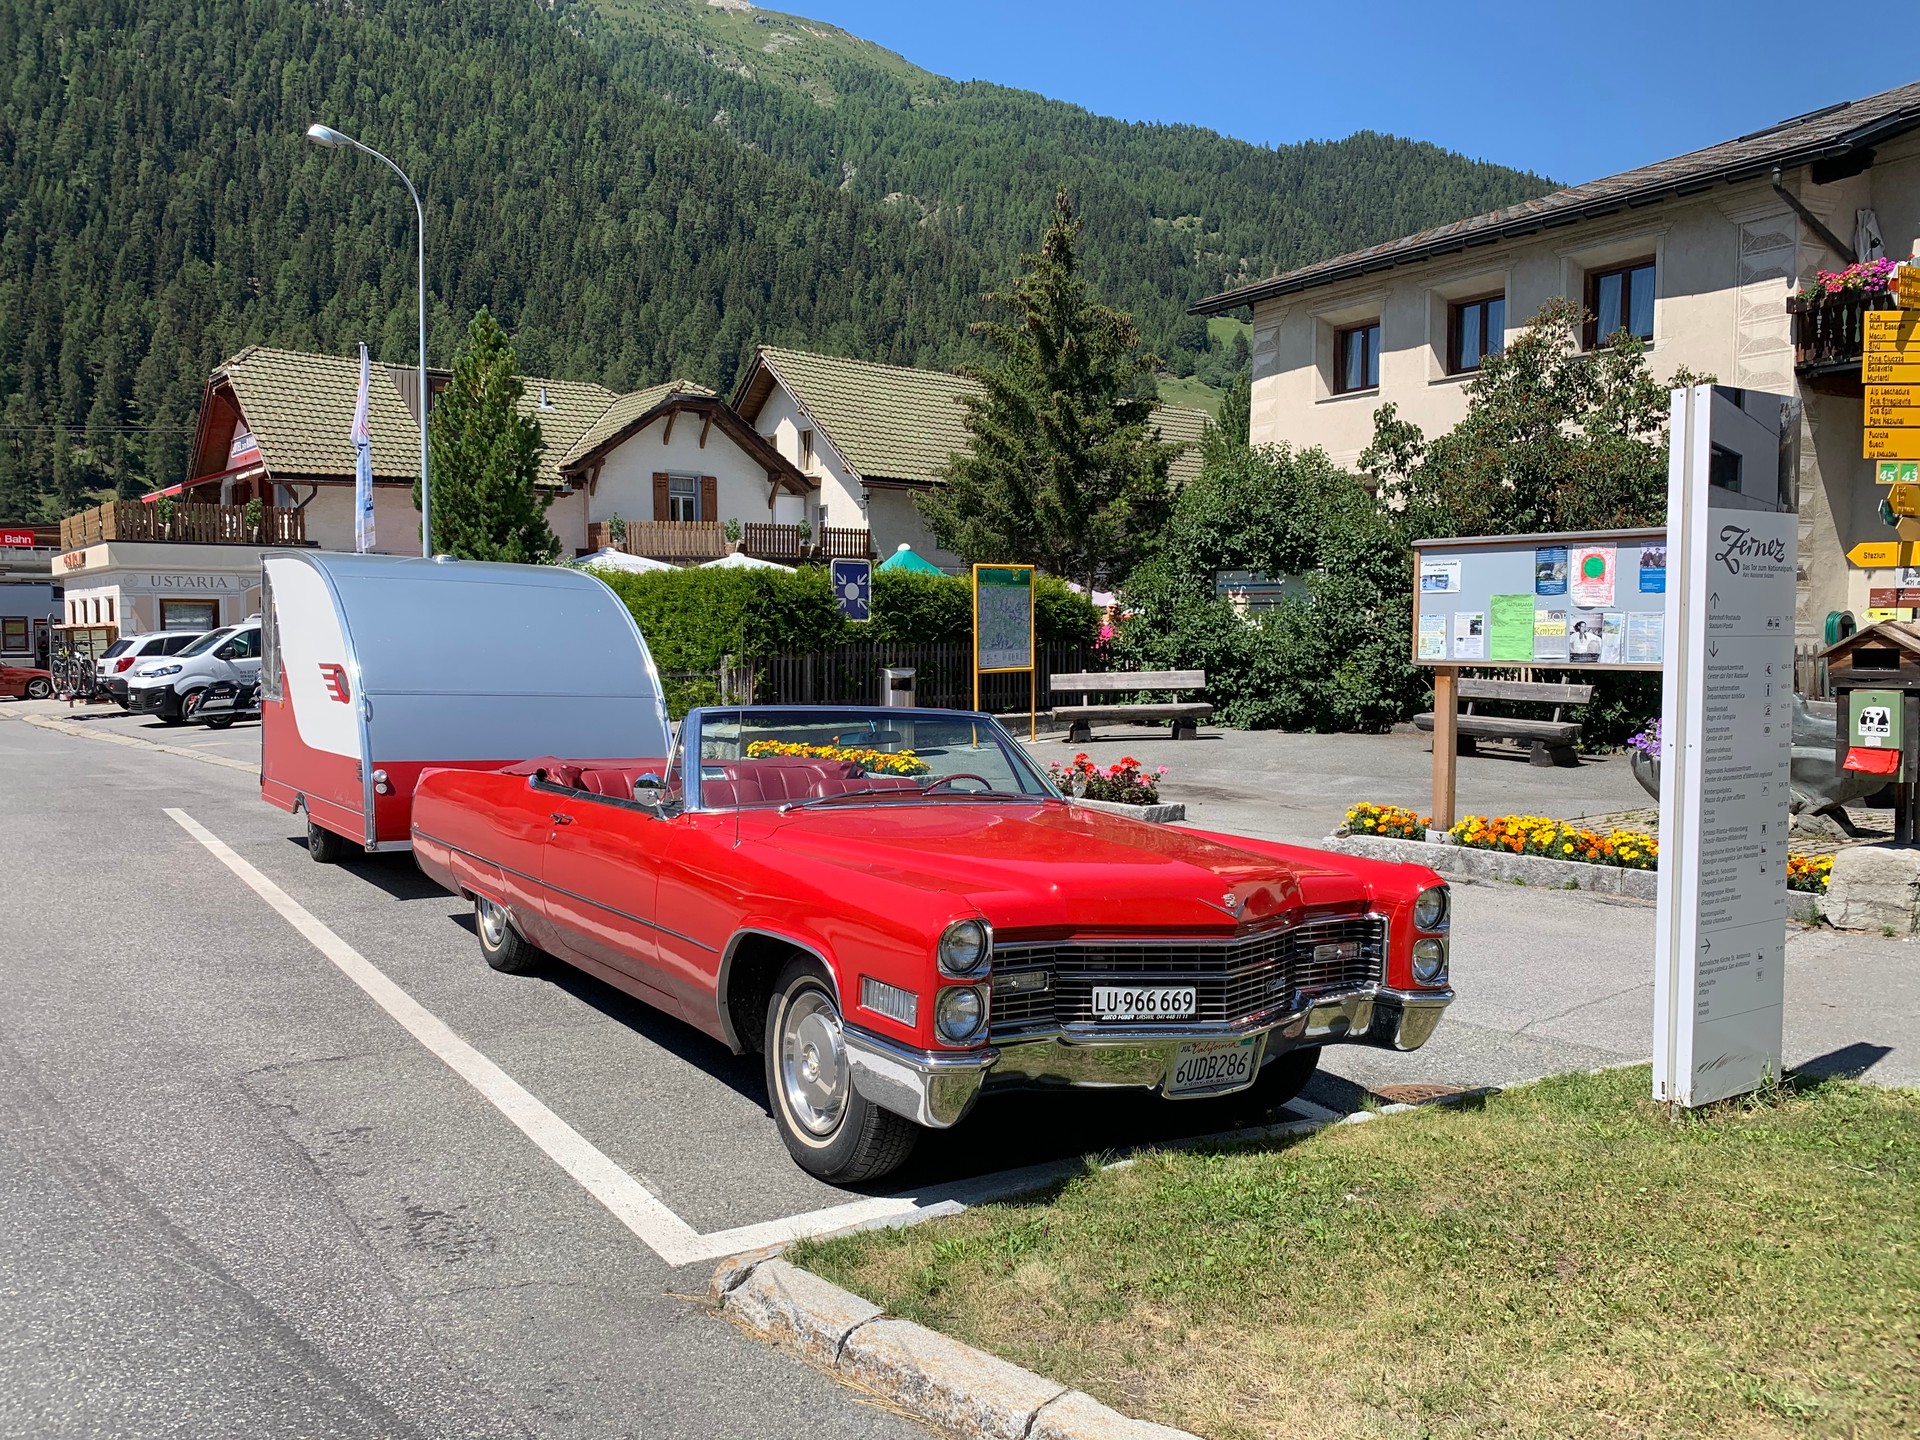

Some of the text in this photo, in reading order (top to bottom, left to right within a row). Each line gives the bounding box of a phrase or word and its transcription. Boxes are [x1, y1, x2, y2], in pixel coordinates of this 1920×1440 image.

[1880, 470, 1894, 481] 45
[1902, 472, 1918, 481] 43
[5, 535, 31, 543] Bahn
[1715, 525, 1785, 575] Zernez
[151, 575, 228, 589] USTARIA
[1181, 1041, 1240, 1055] JUL California
[1176, 1052, 1248, 1083] 6UDB286
[1189, 1077, 1230, 1086] dmv.ca.gov
